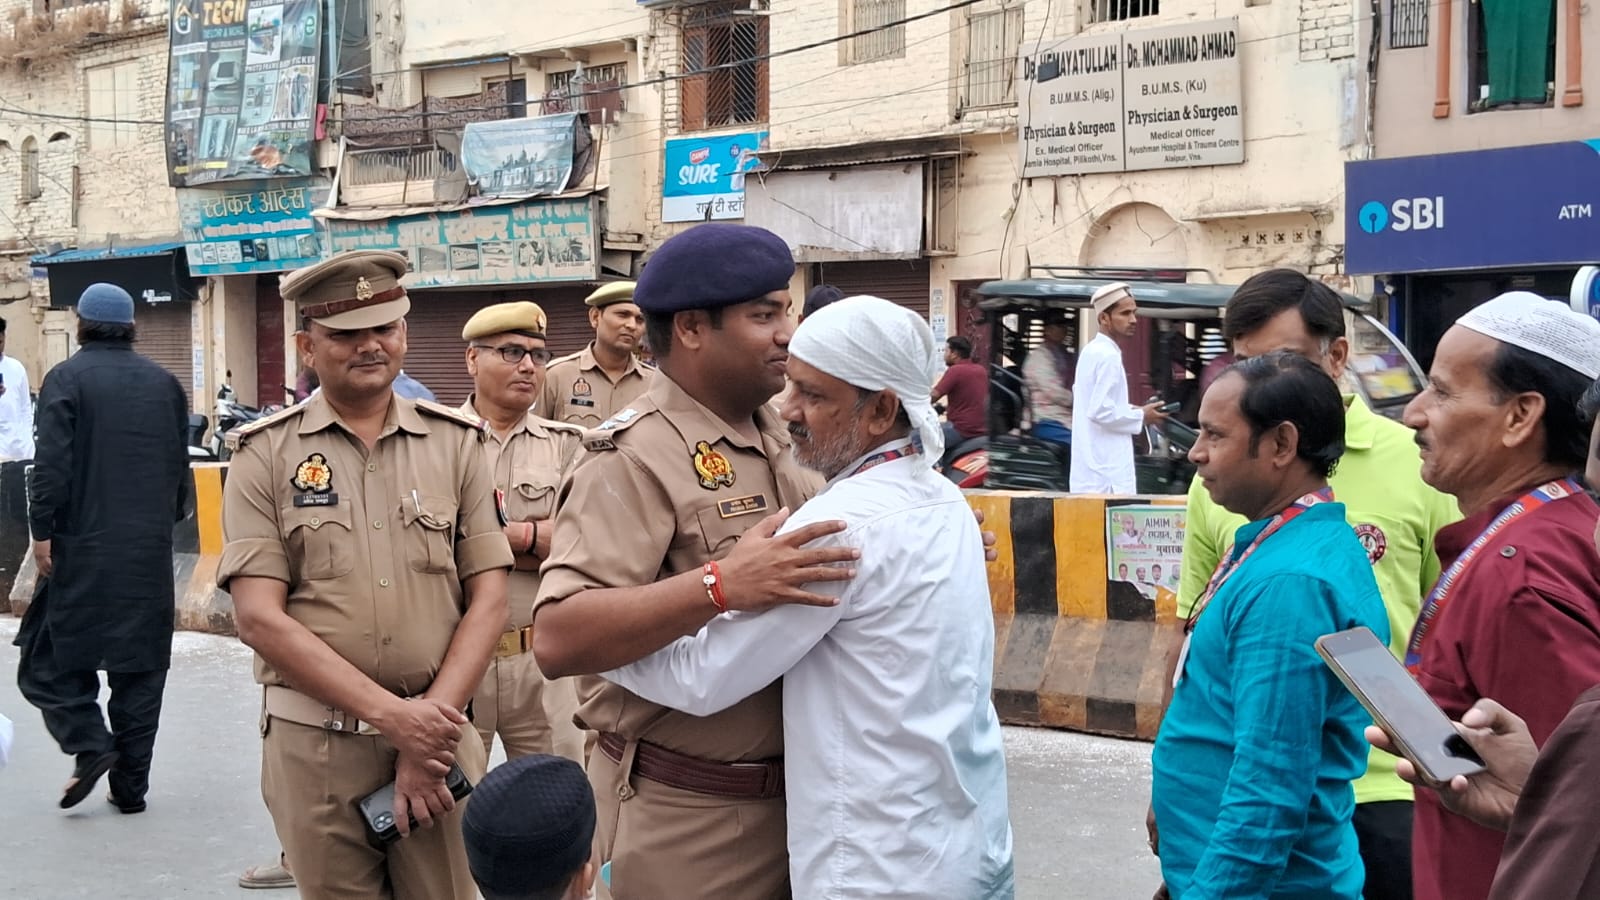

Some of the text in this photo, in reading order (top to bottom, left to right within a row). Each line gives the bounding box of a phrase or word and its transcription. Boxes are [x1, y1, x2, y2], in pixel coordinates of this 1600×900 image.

[1143, 36, 1198, 67] MOHAMMAD
[1201, 31, 1236, 61] AHMAD
[1141, 78, 1207, 96] B.U.M.S. (Ku)
[1092, 88, 1115, 104] (Alig.)
[1128, 104, 1238, 127] Physician & Surgeon
[1024, 120, 1116, 142] Physician & Surgeon
[1150, 128, 1216, 141] Medical Officer
[1035, 142, 1104, 156] Ex. Medical Officer
[1161, 142, 1187, 153] Hospital
[1188, 142, 1193, 150] &
[1194, 140, 1217, 150] Trauma
[1218, 138, 1239, 148] Centre
[678, 163, 720, 186] SURE
[715, 197, 725, 213] टी
[1558, 203, 1592, 220] ATM
[1392, 196, 1444, 232] SBI
[1145, 518, 1170, 529] AIMIM
